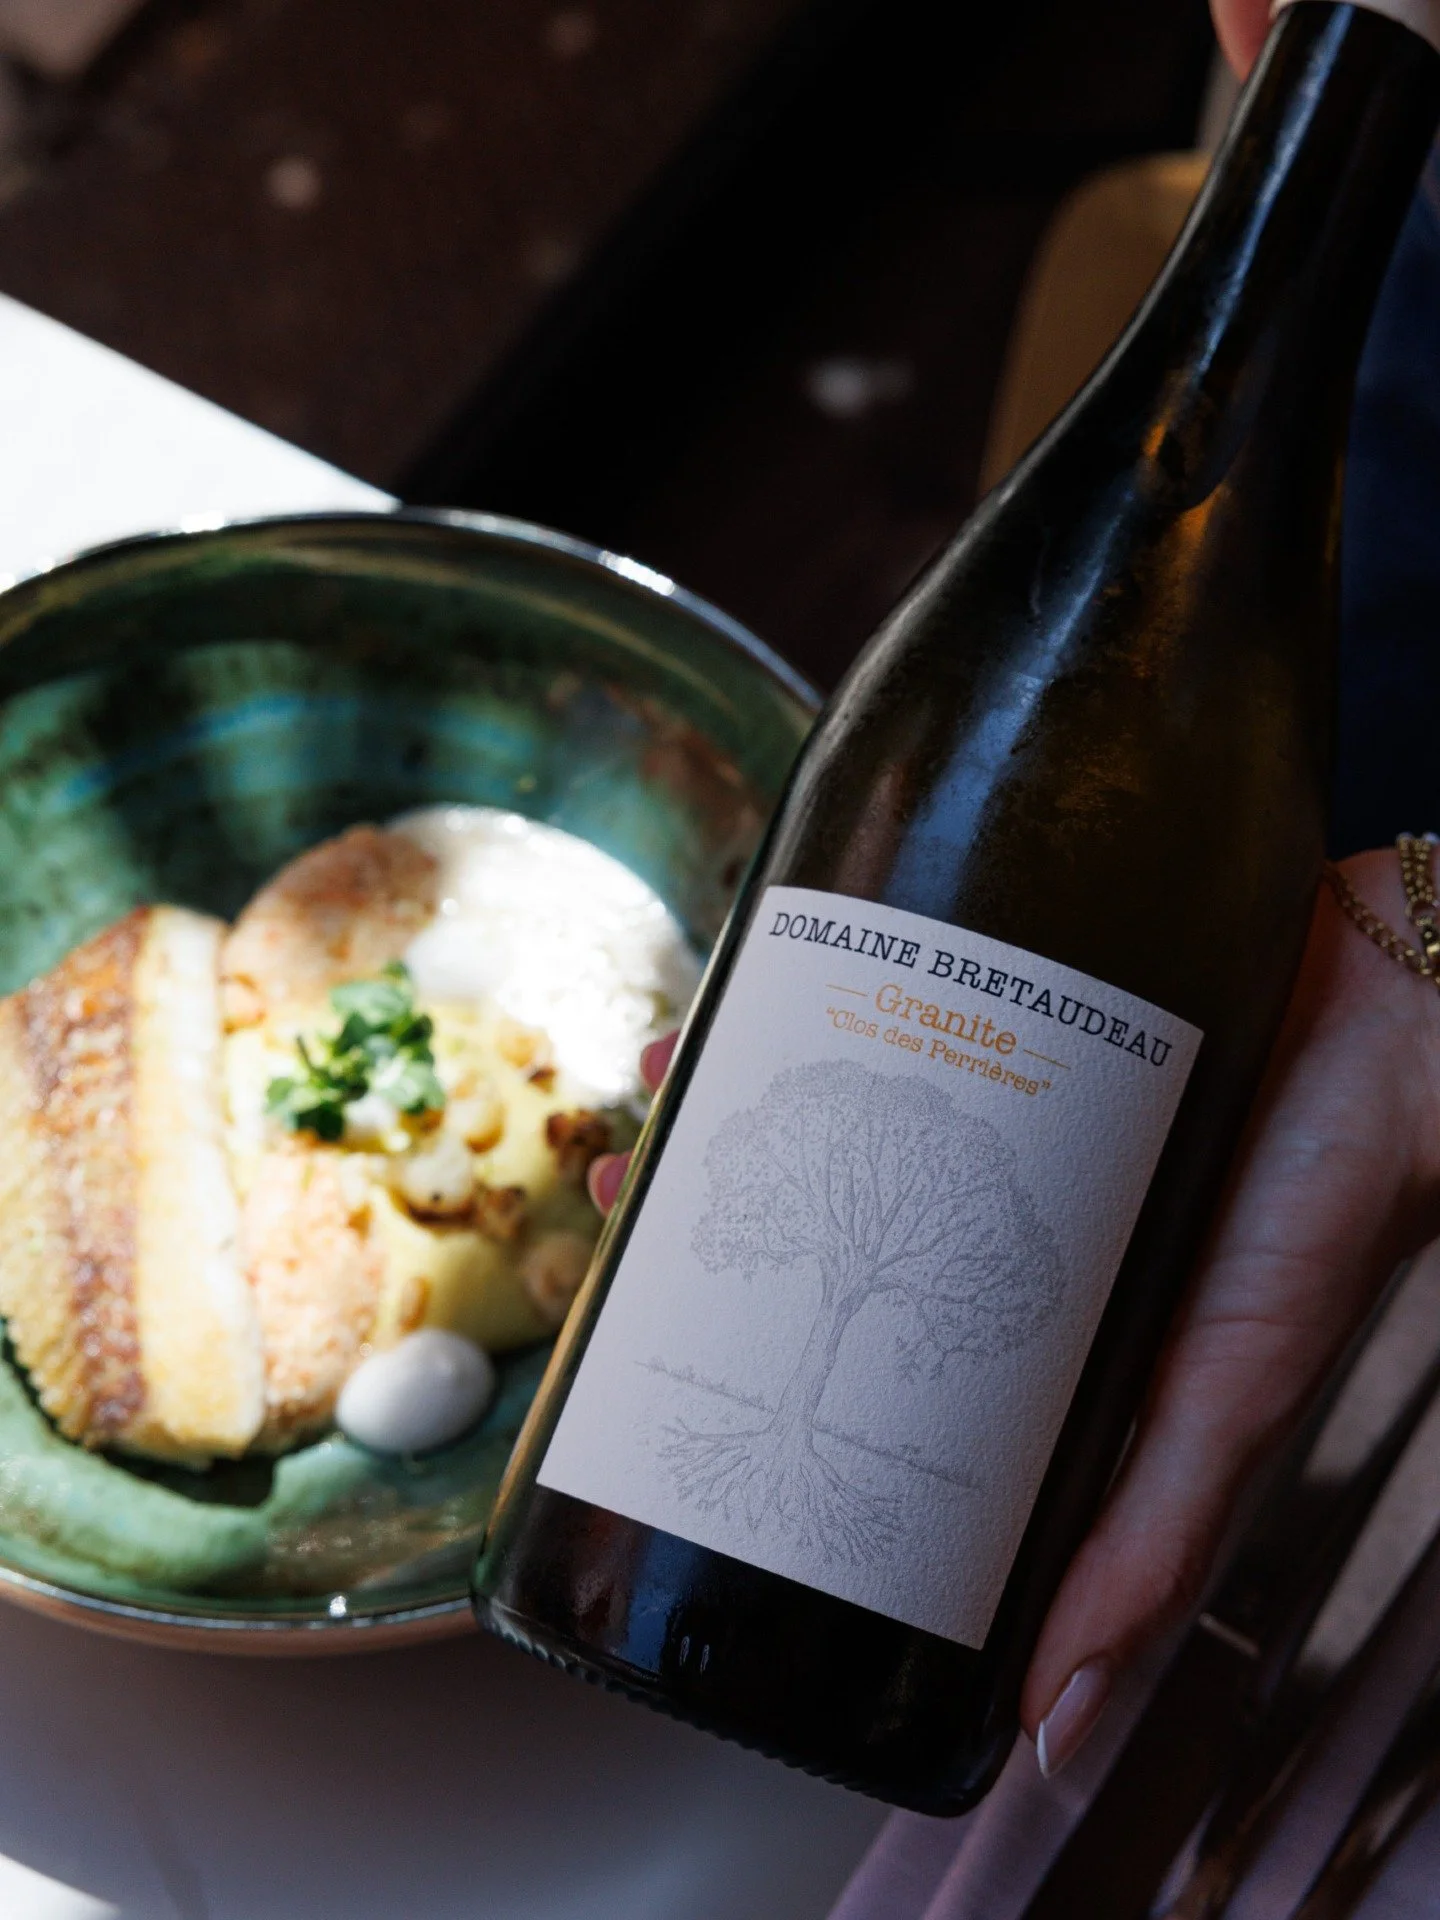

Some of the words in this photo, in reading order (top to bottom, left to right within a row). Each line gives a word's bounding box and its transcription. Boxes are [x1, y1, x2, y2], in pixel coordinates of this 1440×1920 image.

[769, 912, 921, 969] DOMAINE
[927, 949, 1173, 1067] BRETAUDEAU
[874, 983, 1018, 1056] Granite
[826, 1006, 879, 1040] “Clos
[883, 1025, 924, 1053] des
[927, 1039, 1052, 1097] Perrières”
